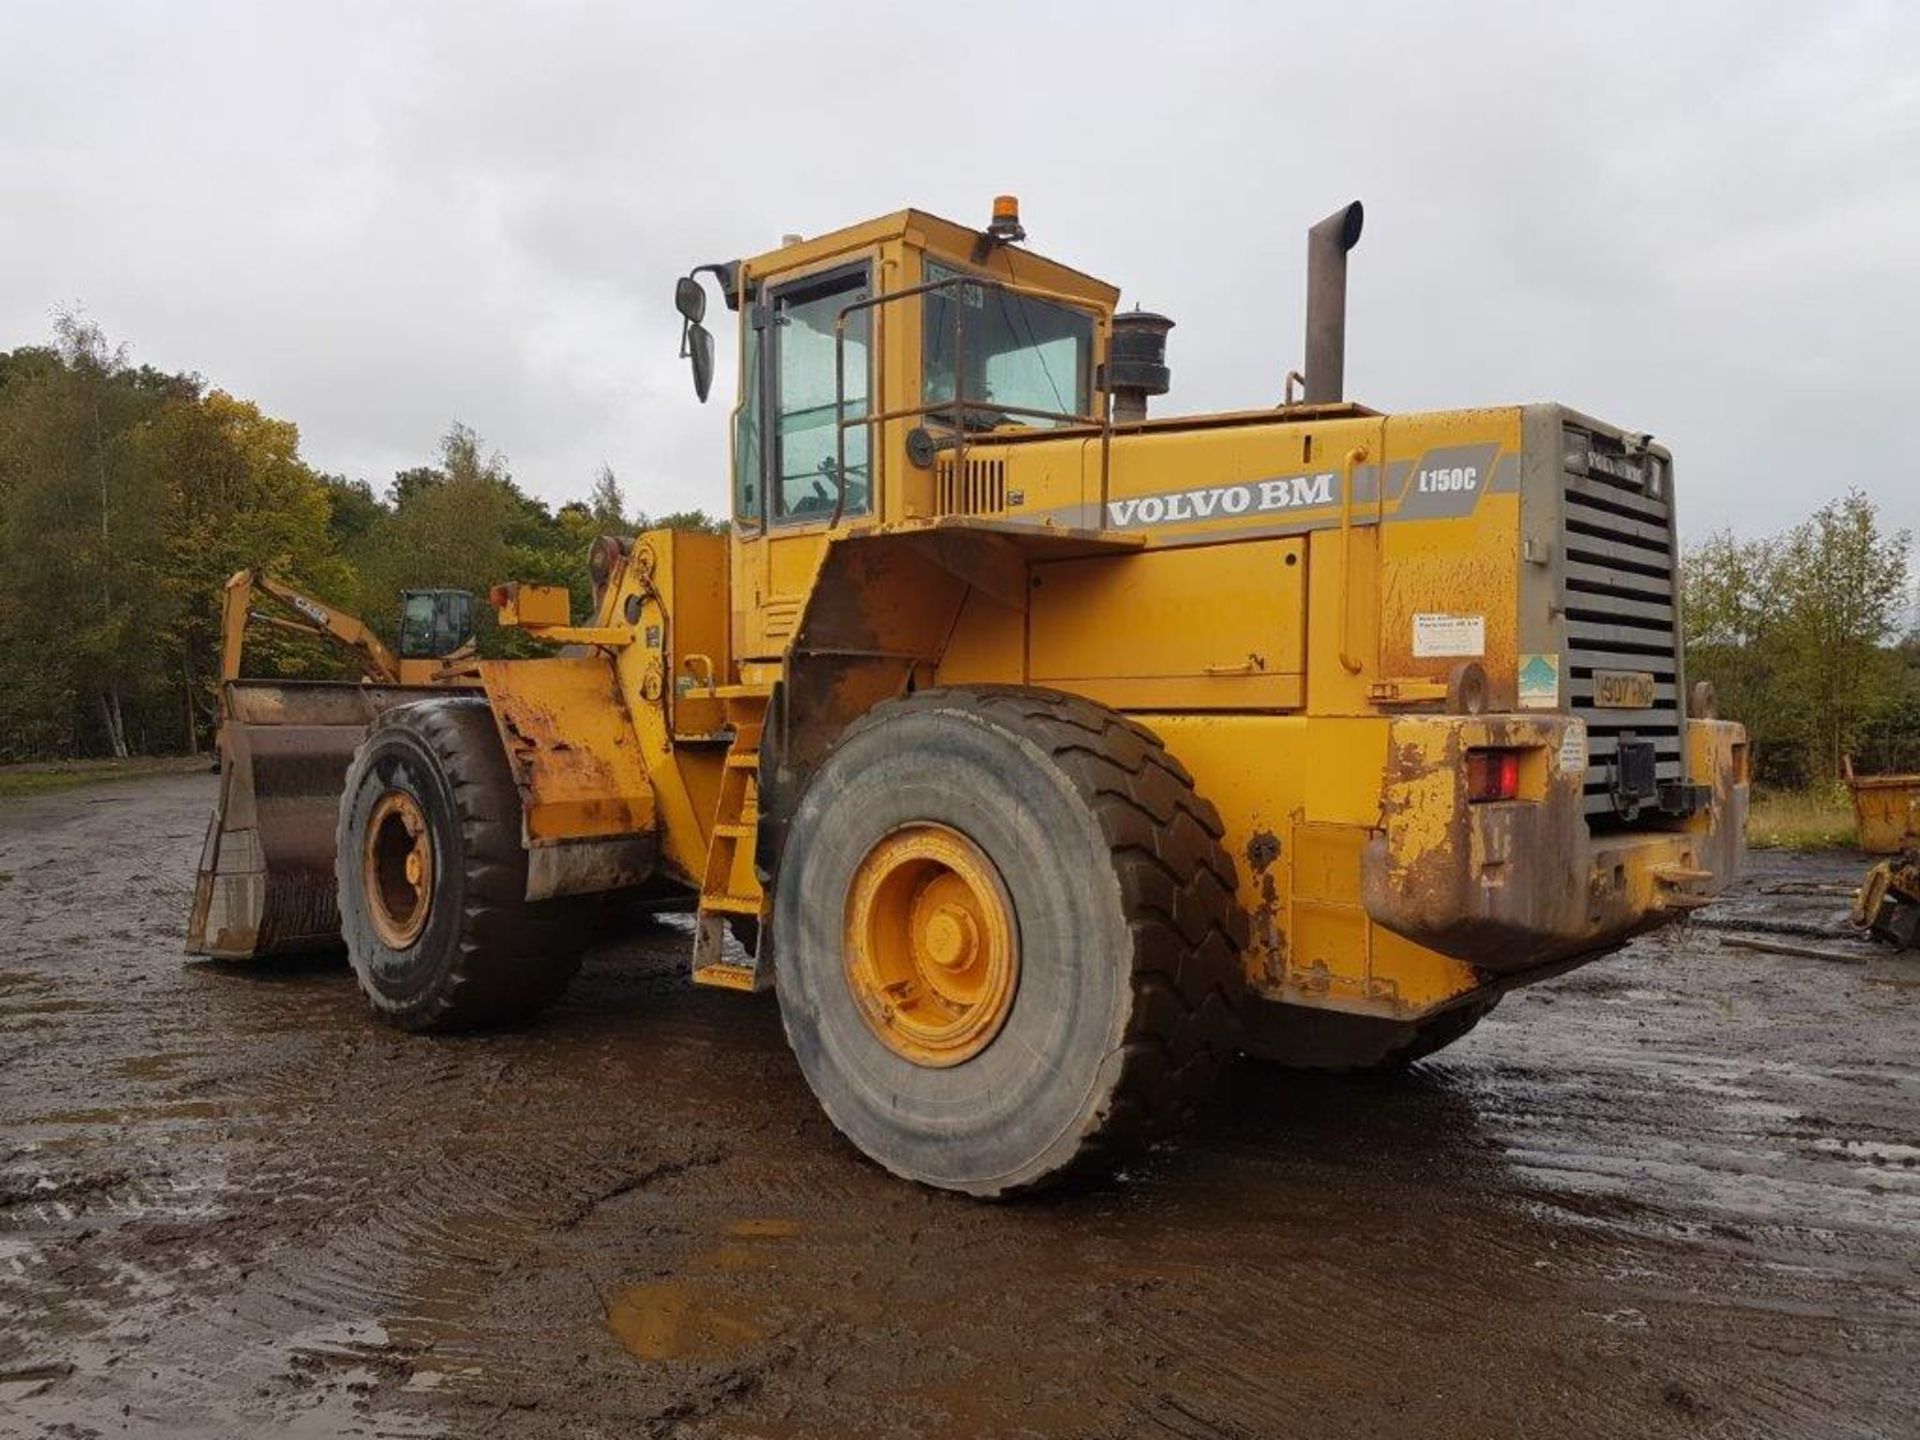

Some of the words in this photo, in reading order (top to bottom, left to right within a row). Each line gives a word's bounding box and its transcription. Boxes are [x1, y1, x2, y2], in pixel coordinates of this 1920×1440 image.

[1419, 466, 1477, 492] L150C
[1107, 486, 1251, 526] VOLVO
[1258, 474, 1334, 510] BM
